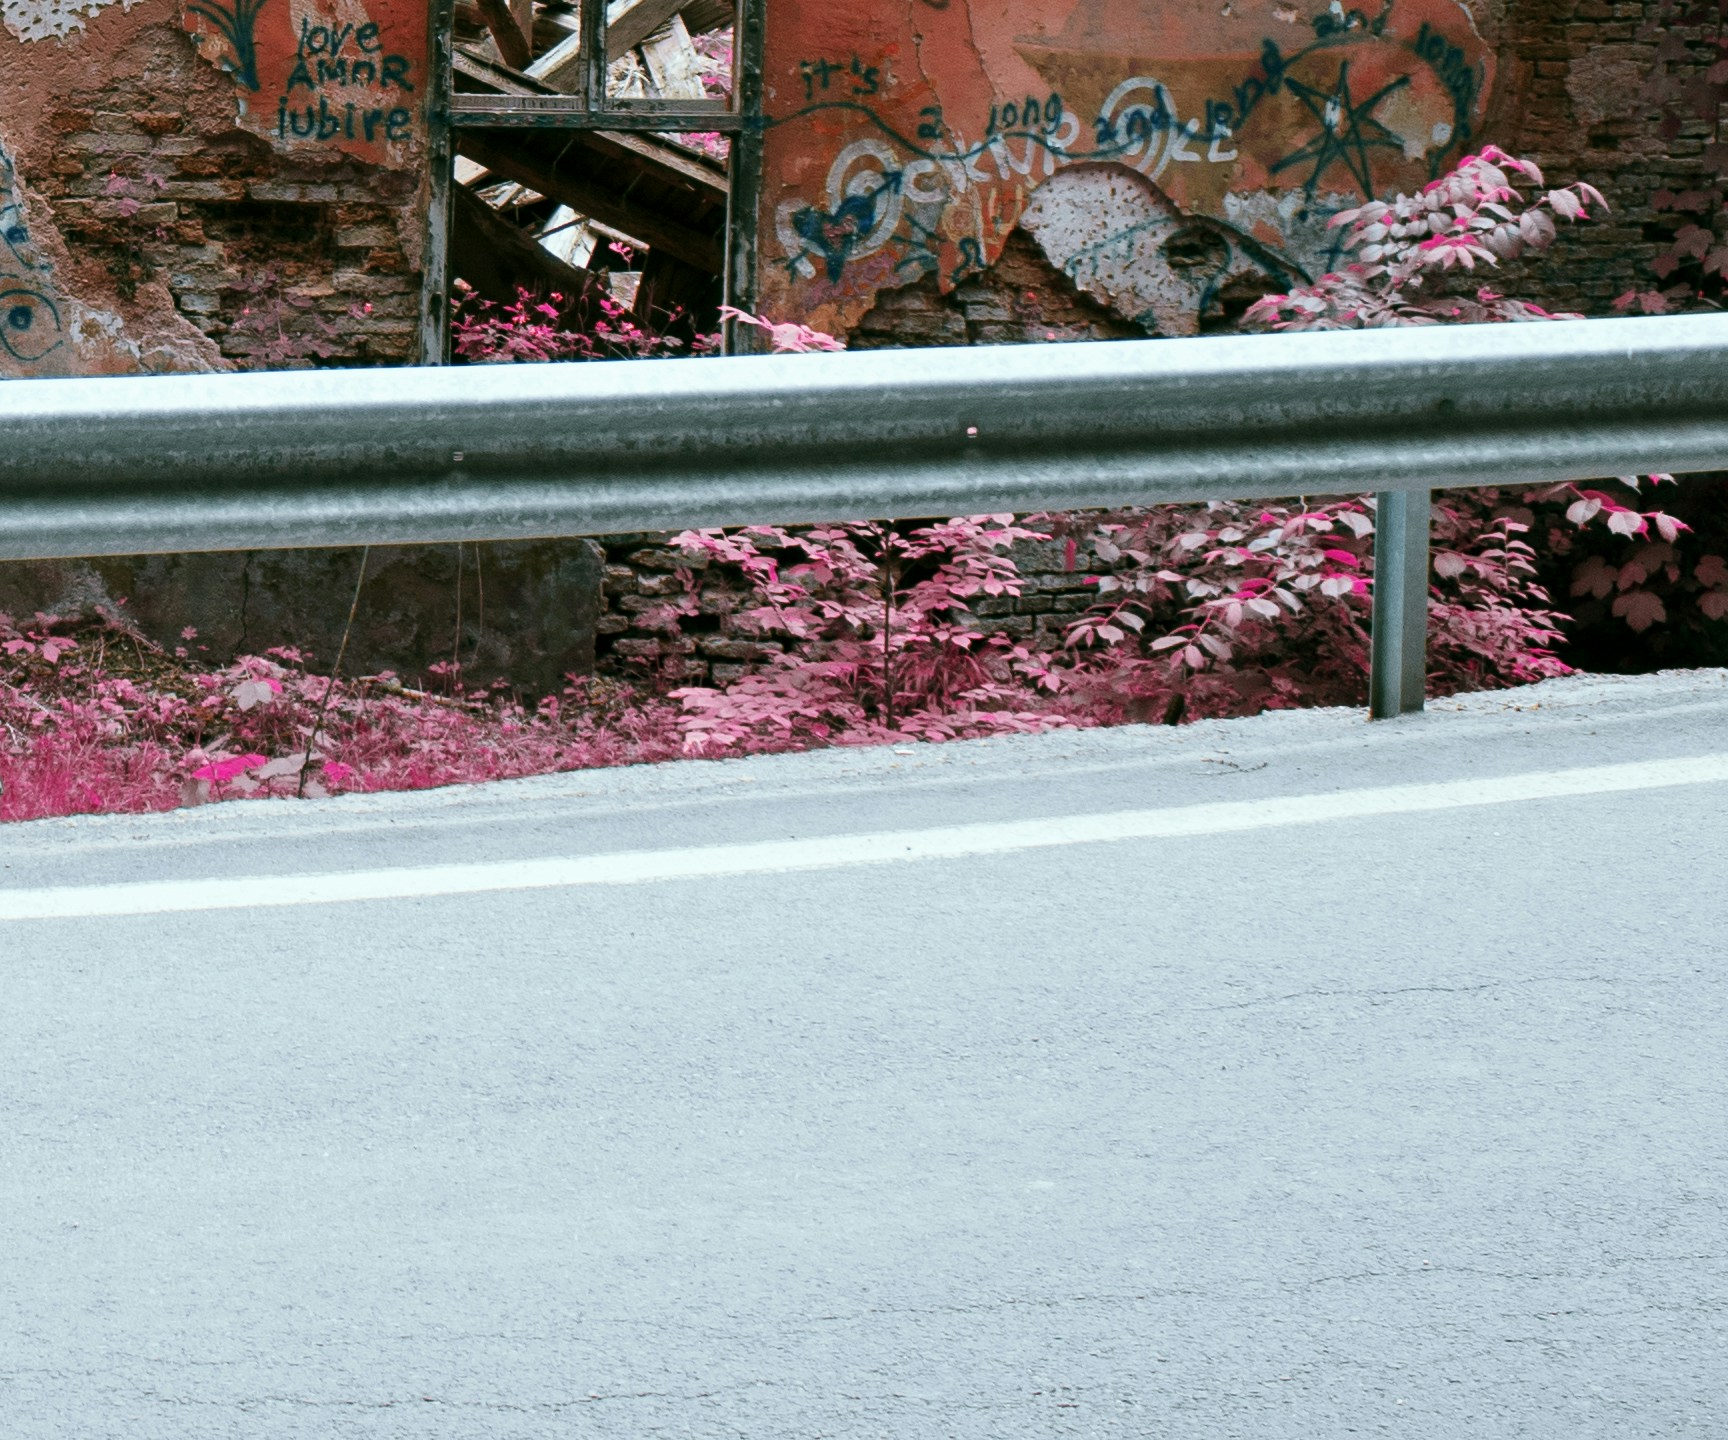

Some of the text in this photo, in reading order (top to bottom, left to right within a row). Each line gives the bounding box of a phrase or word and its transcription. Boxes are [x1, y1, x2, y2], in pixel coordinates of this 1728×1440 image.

[298, 14, 383, 60] love
[277, 96, 414, 143] iubire
[986, 91, 1064, 136] long
